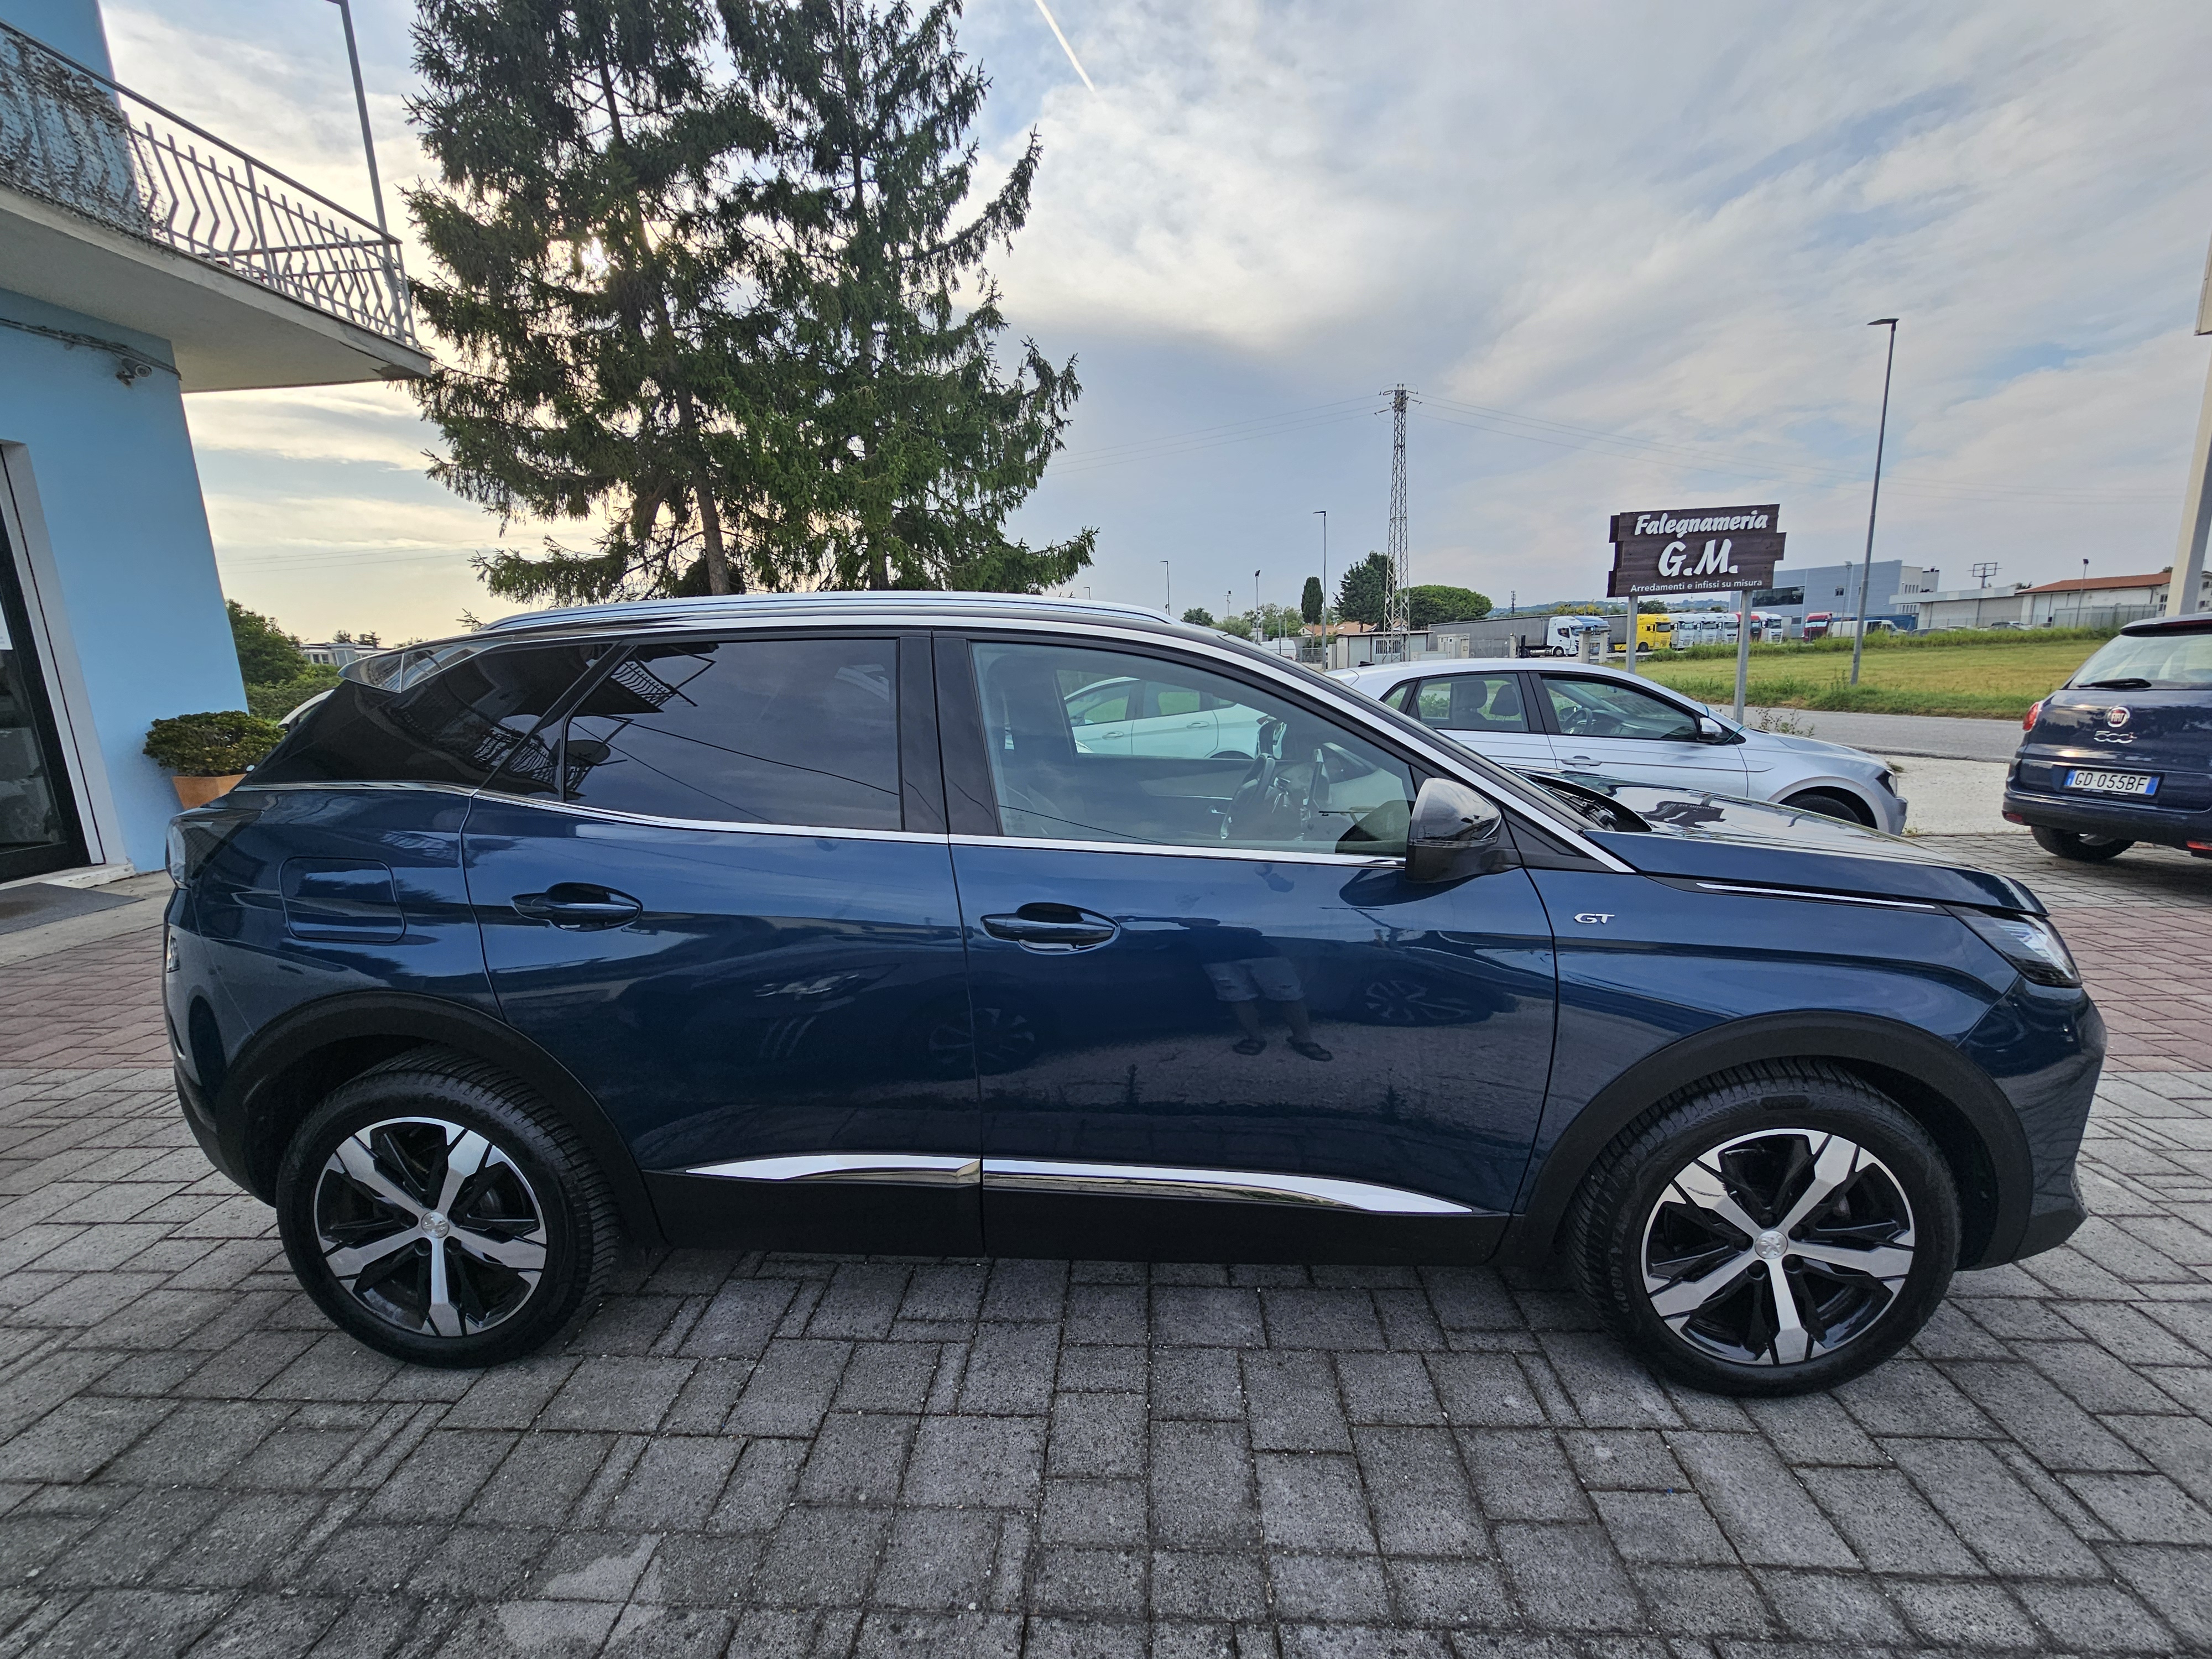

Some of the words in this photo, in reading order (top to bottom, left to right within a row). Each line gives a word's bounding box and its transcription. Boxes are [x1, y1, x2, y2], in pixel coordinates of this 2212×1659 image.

[1634, 510, 1768, 539] Falegnameria
[1658, 539, 1739, 577] G.M.
[1630, 582, 1685, 592] Arredamenti
[1695, 581, 1719, 589] infissi
[2110, 713, 2125, 722] FIAT
[1574, 913, 1615, 924] GT
